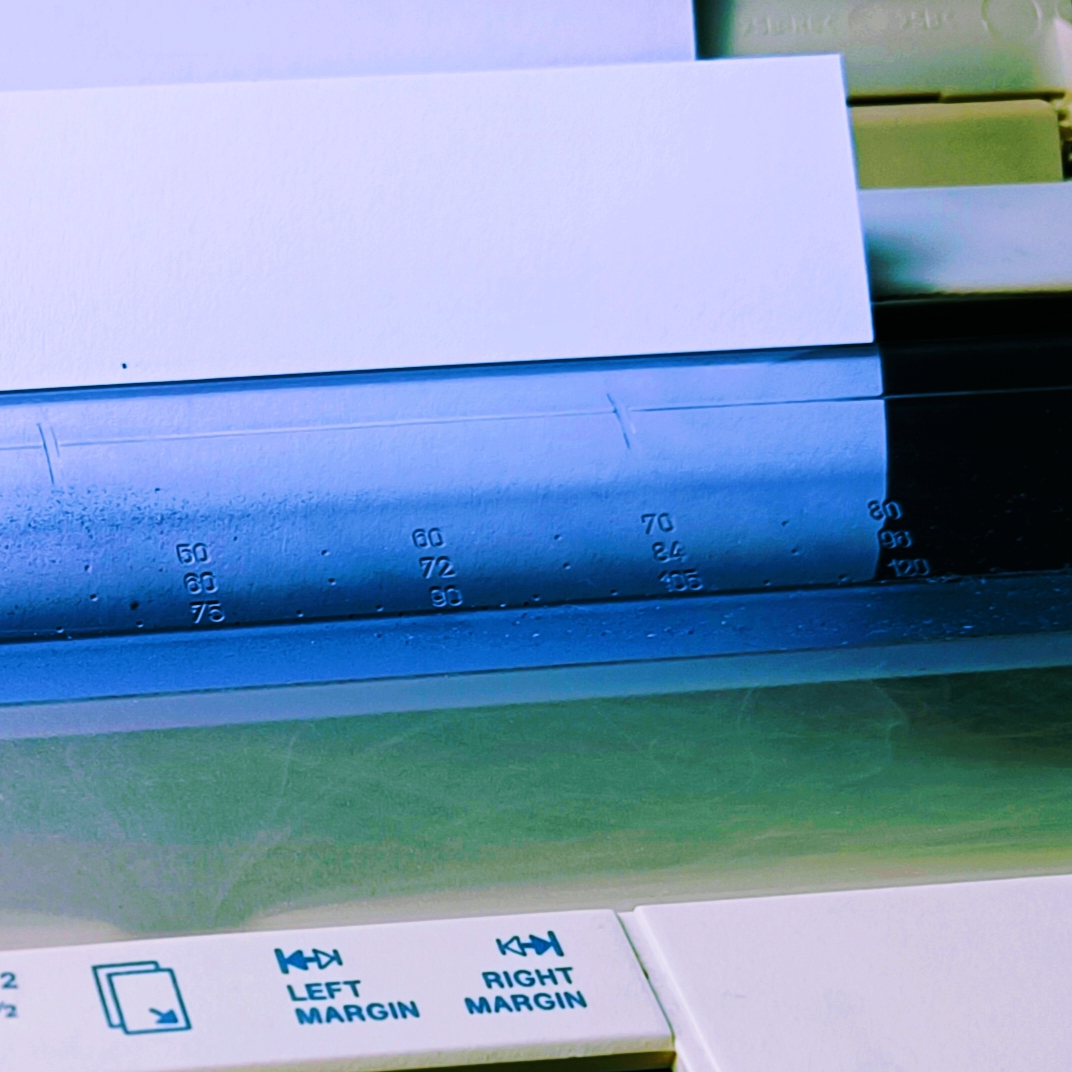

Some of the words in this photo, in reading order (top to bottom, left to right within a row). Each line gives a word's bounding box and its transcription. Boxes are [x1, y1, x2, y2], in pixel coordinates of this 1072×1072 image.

[176, 543, 210, 565] 50
[412, 528, 445, 548] 60
[641, 512, 674, 535] 70
[868, 500, 902, 520] 80
[184, 572, 218, 594] 60
[419, 556, 456, 578] 72
[652, 541, 687, 562] 84
[190, 601, 225, 623] 75
[430, 585, 463, 607] 90
[658, 569, 704, 591] 105
[887, 558, 930, 577] 120
[0, 971, 18, 989] 2
[286, 979, 361, 1002] LEFT
[481, 966, 573, 990] RIGHT
[294, 1000, 420, 1025] MARGIN
[464, 990, 588, 1015] MARGIN
